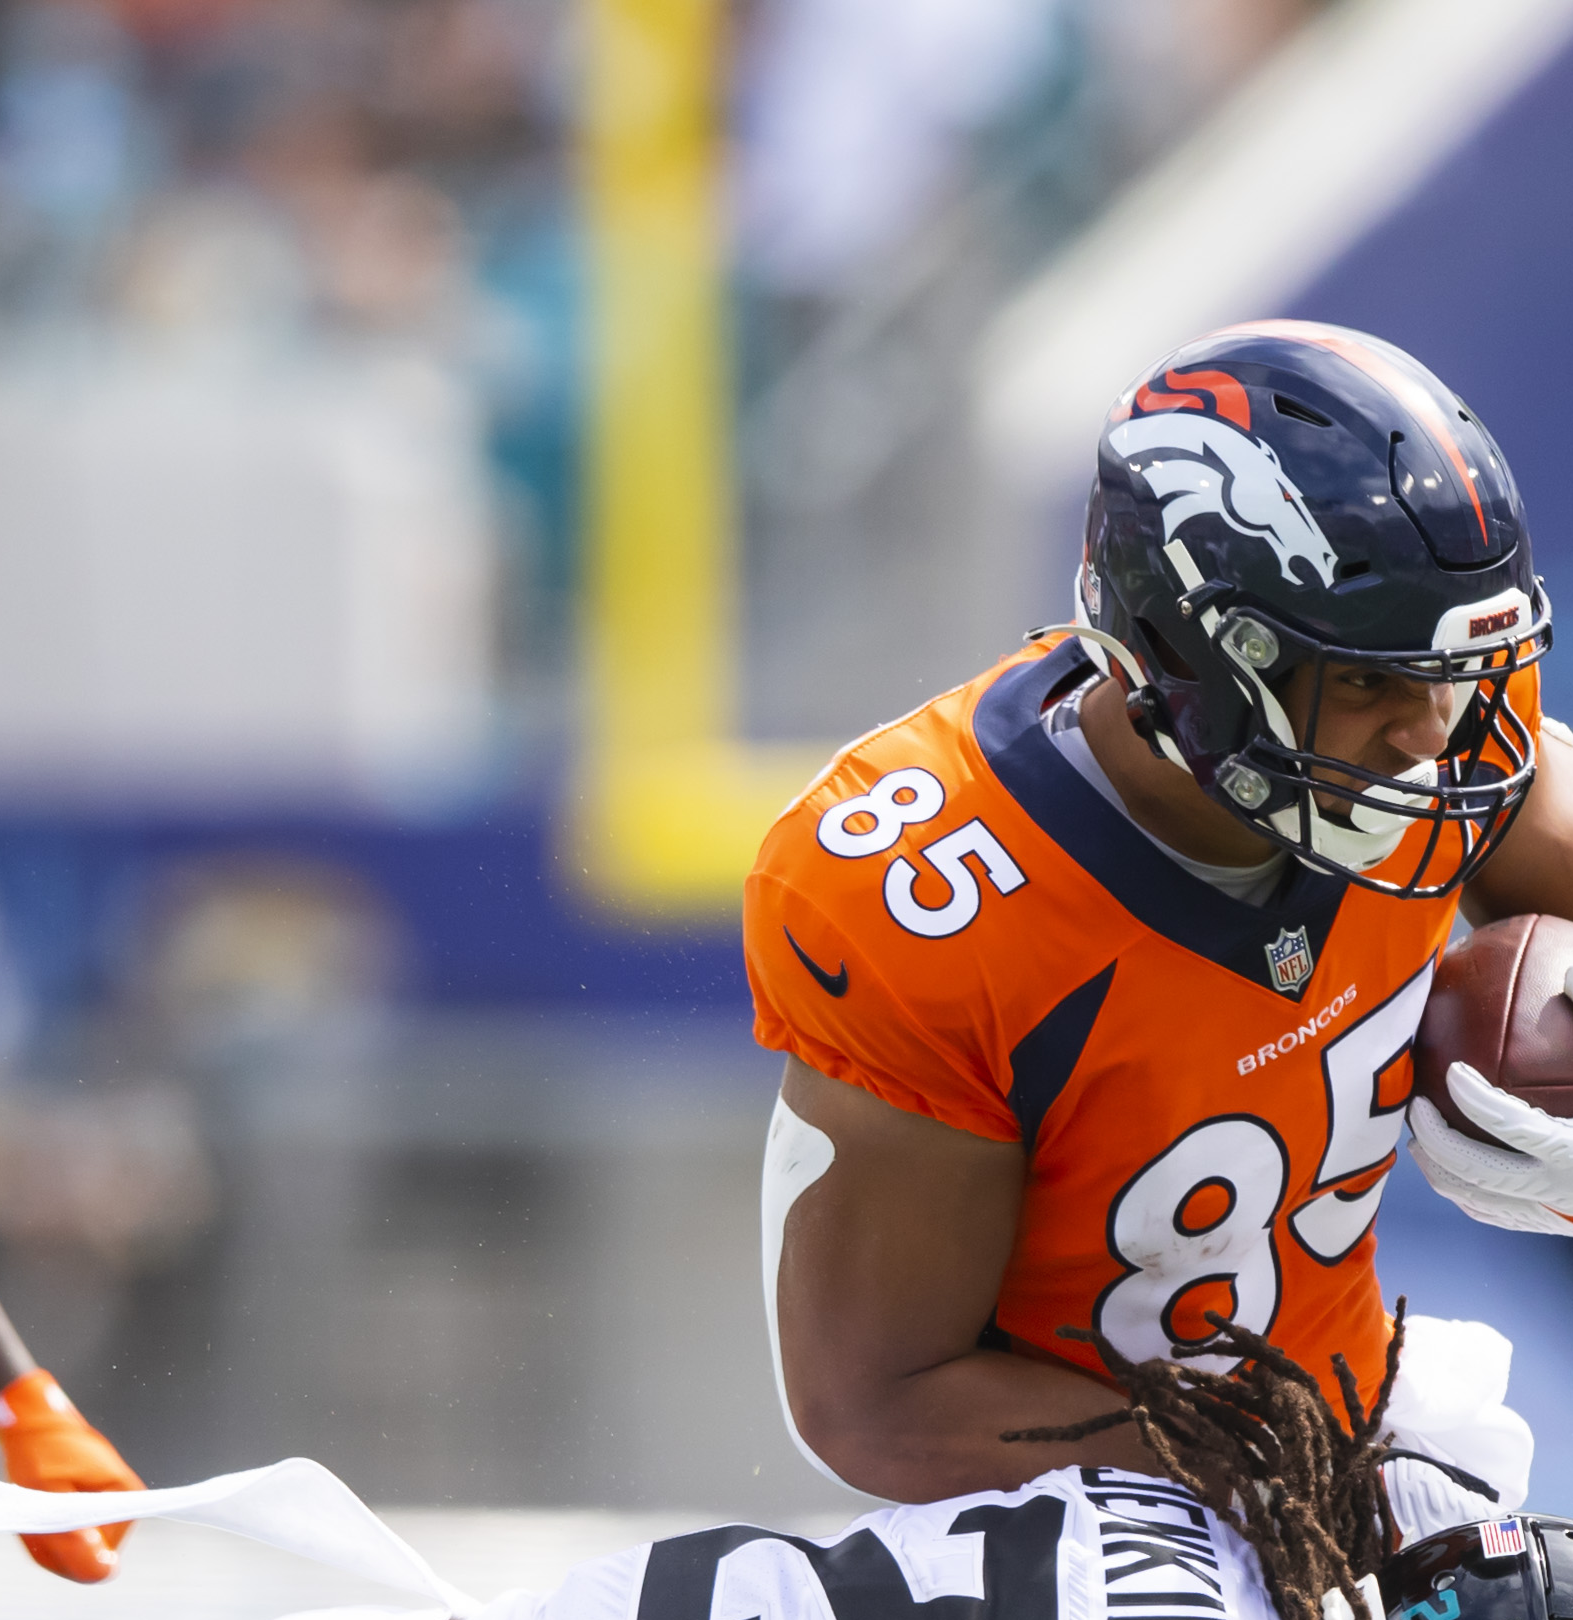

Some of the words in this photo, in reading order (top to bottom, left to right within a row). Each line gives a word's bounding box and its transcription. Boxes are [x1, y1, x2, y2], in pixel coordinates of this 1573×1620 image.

[1469, 606, 1519, 639] BRONCOS
[817, 767, 1030, 940] 85
[1277, 955, 1308, 983] NFL
[1236, 984, 1358, 1077] BRONCOS
[1092, 943, 1438, 1392] 85
